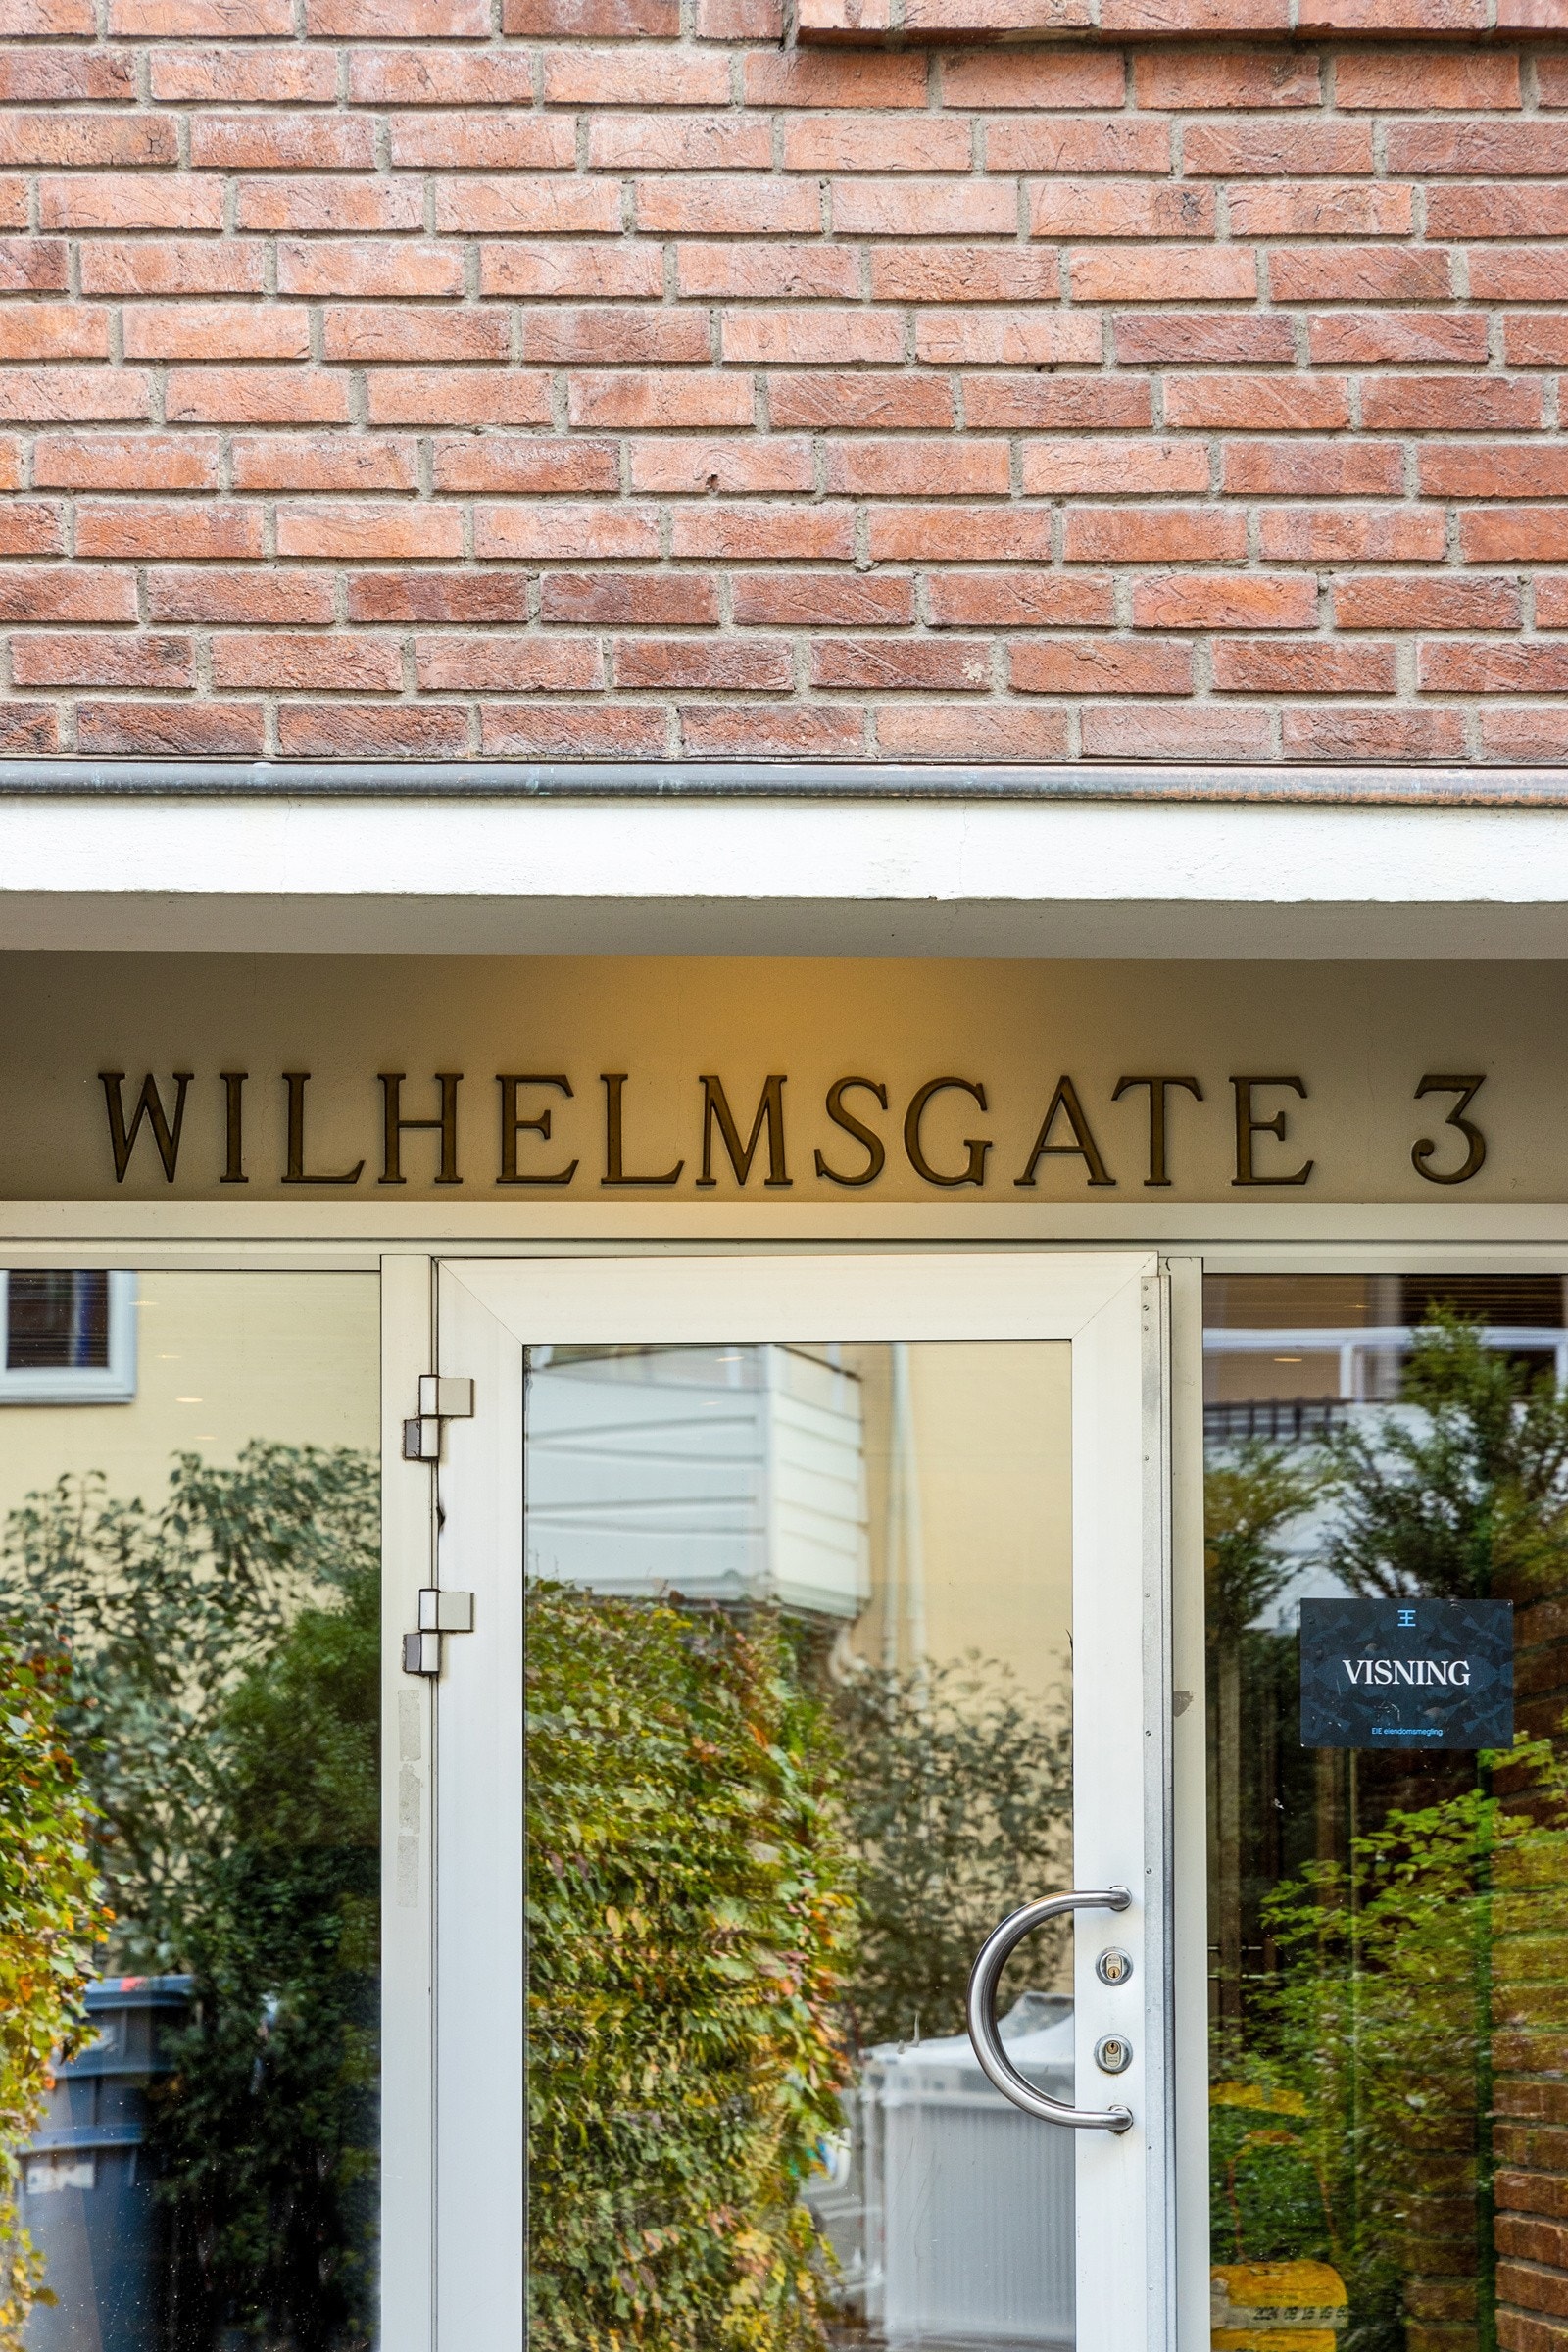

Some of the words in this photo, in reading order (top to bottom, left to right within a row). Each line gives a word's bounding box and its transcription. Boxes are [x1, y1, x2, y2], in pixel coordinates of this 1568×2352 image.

[98, 1073, 1314, 1187] WILHELMSGATE
[1411, 1074, 1488, 1185] 3
[1343, 1659, 1471, 1685] VISNING
[1384, 1727, 1444, 1737] eiendomsmegling
